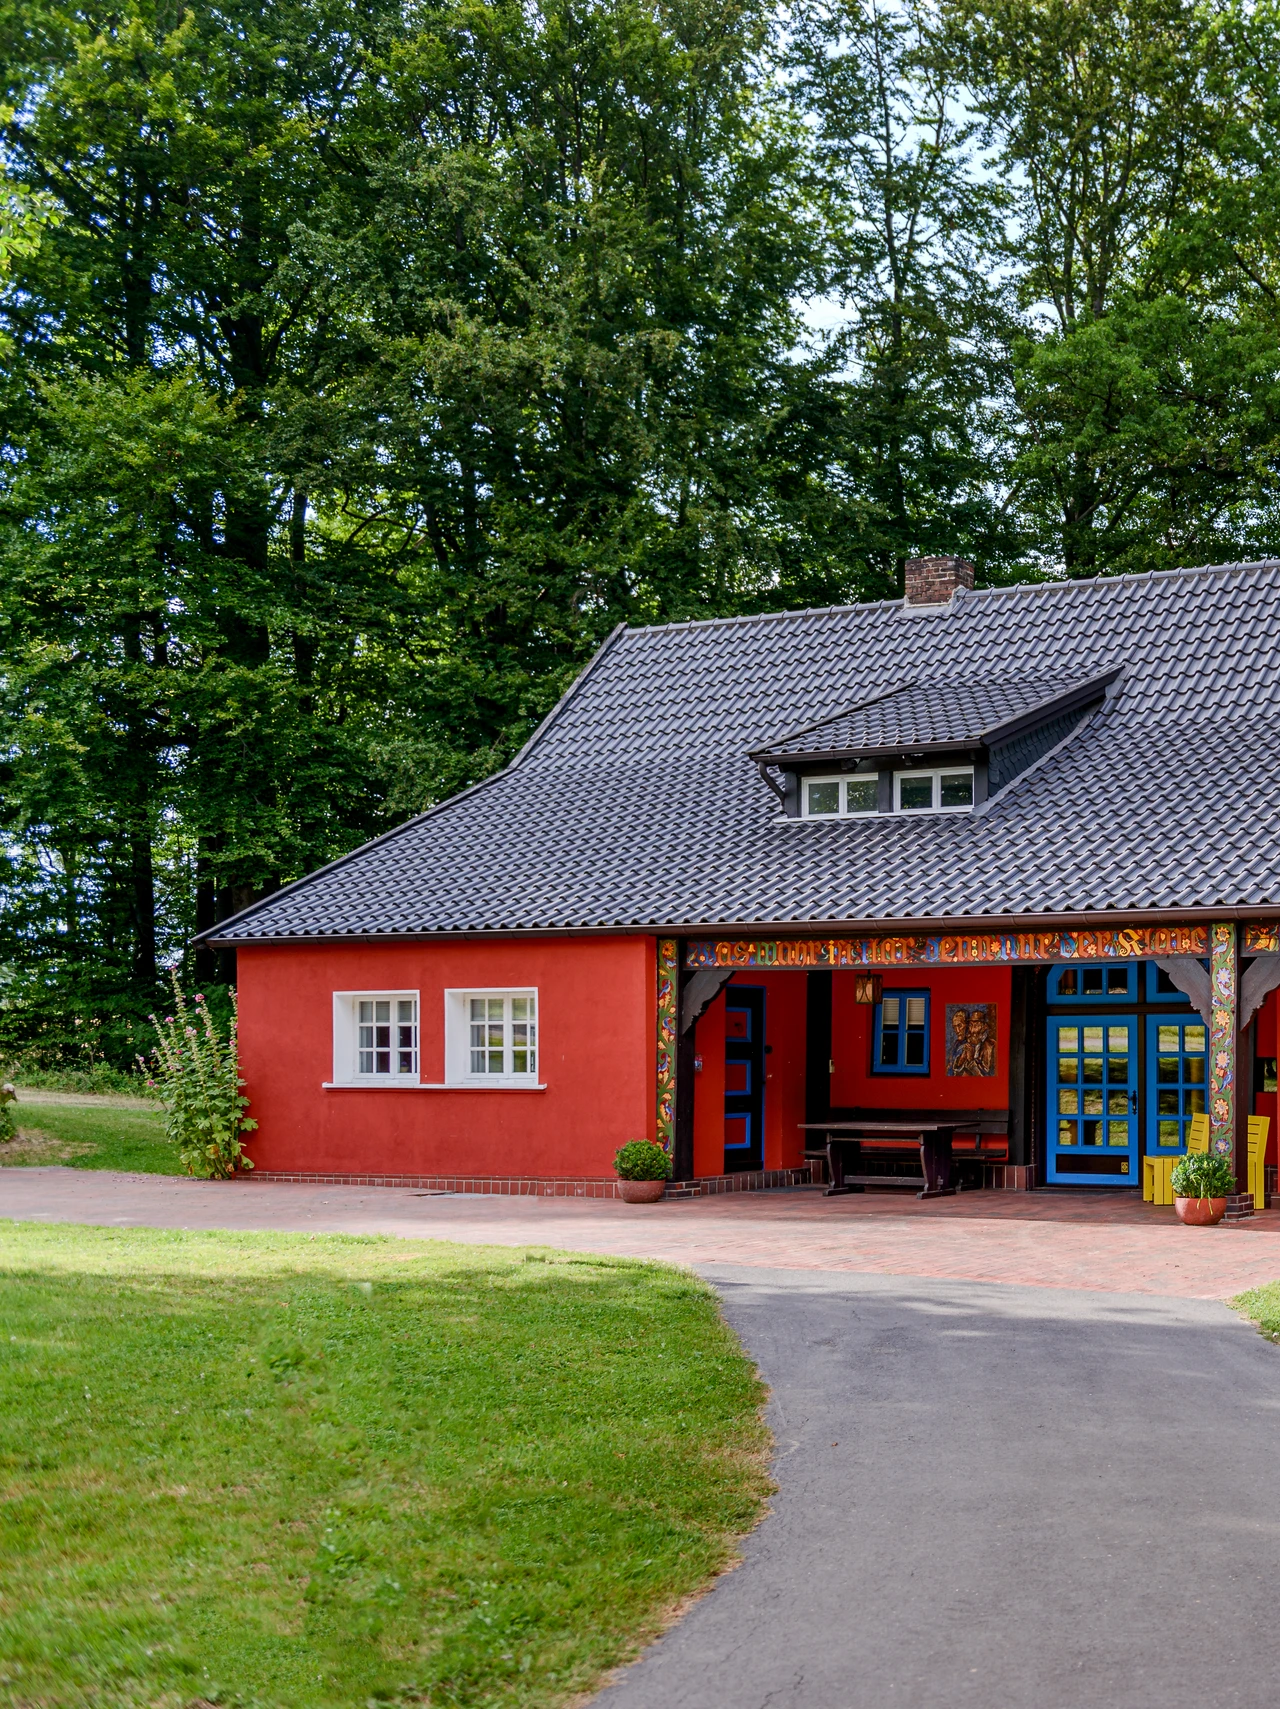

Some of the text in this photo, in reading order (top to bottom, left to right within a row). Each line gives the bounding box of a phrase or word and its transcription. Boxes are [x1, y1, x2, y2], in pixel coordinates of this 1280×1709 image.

[688, 940, 750, 966] Was
[925, 935, 993, 963] denn
[1058, 931, 1112, 959] der
